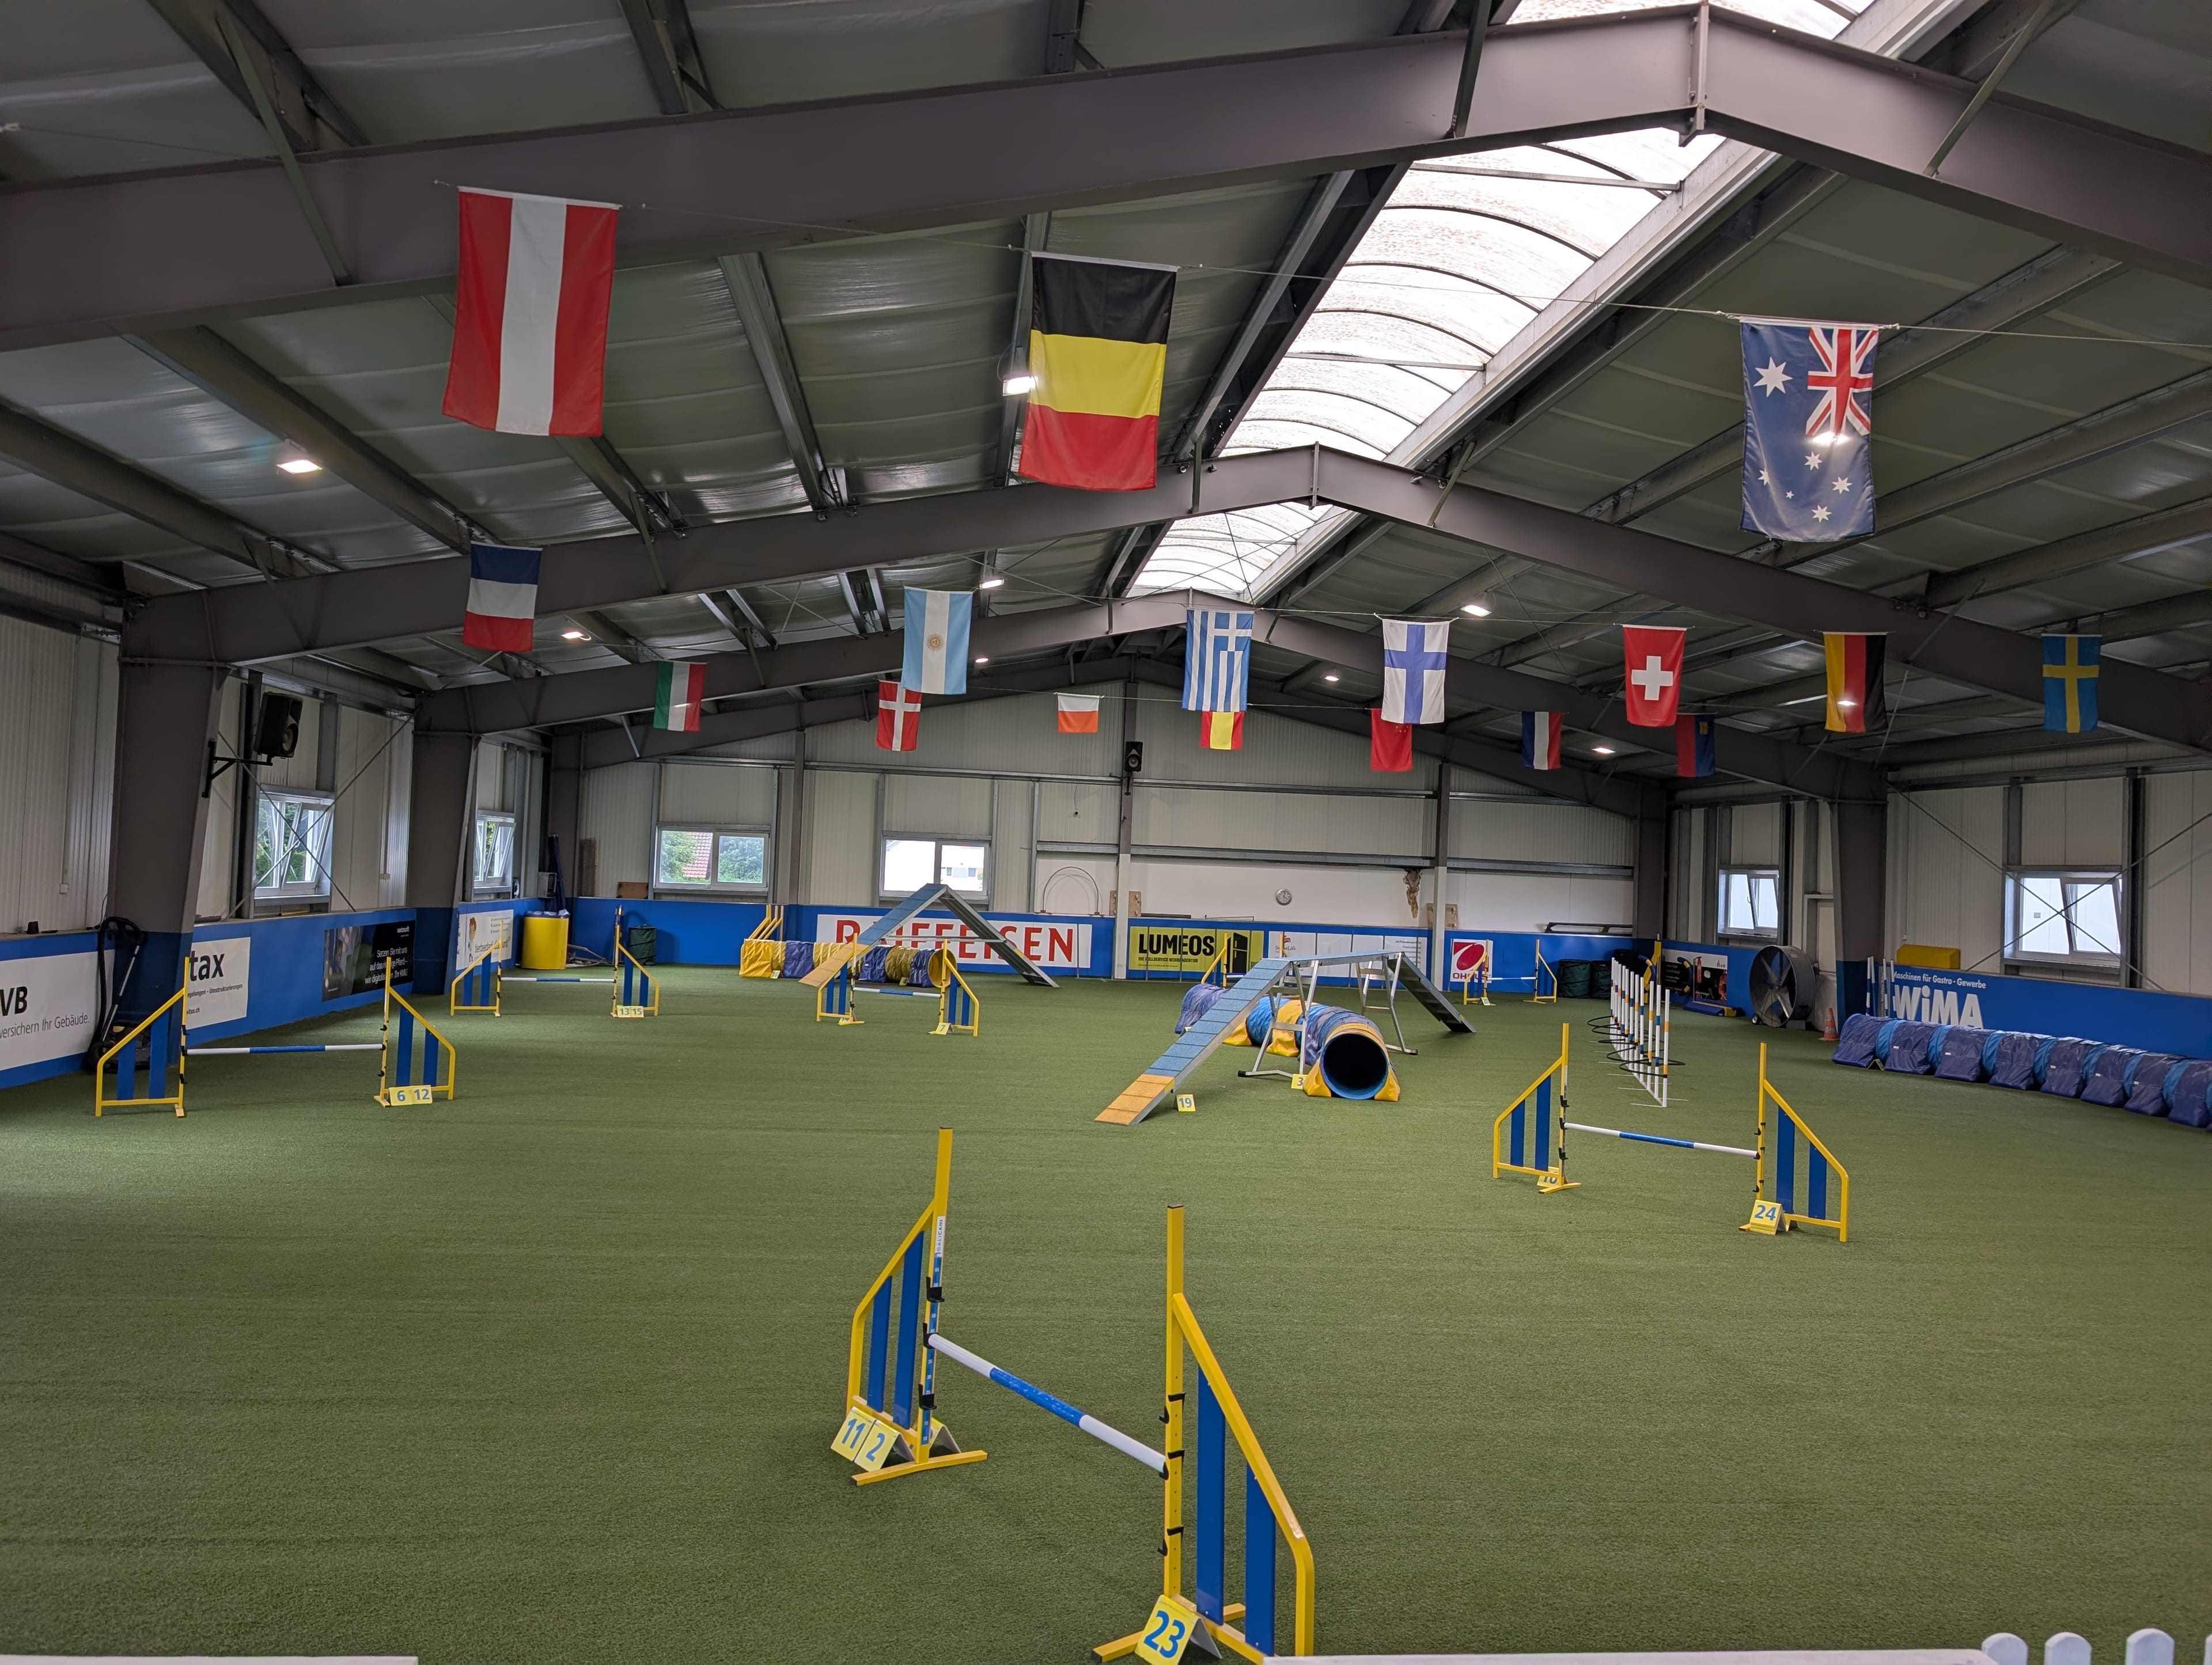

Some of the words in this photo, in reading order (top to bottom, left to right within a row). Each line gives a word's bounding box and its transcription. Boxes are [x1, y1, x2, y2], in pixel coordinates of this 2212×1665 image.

[1138, 934, 1214, 956] LUMEOS
[1922, 973, 1931, 983] für
[1933, 974, 1952, 985] Gastro
[1957, 978, 1986, 989] Gewerbe
[42, 1018, 52, 1031] Ihr
[55, 1012, 89, 1029] Gebäude.
[1297, 1077, 1303, 1086] 3
[397, 1090, 406, 1102] 6
[414, 1088, 430, 1100] 12
[1179, 1097, 1192, 1108] 19
[1755, 1204, 1777, 1221] 24
[842, 1419, 866, 1449] 11
[866, 1432, 885, 1462] 2
[1143, 1610, 1185, 1658] 23
